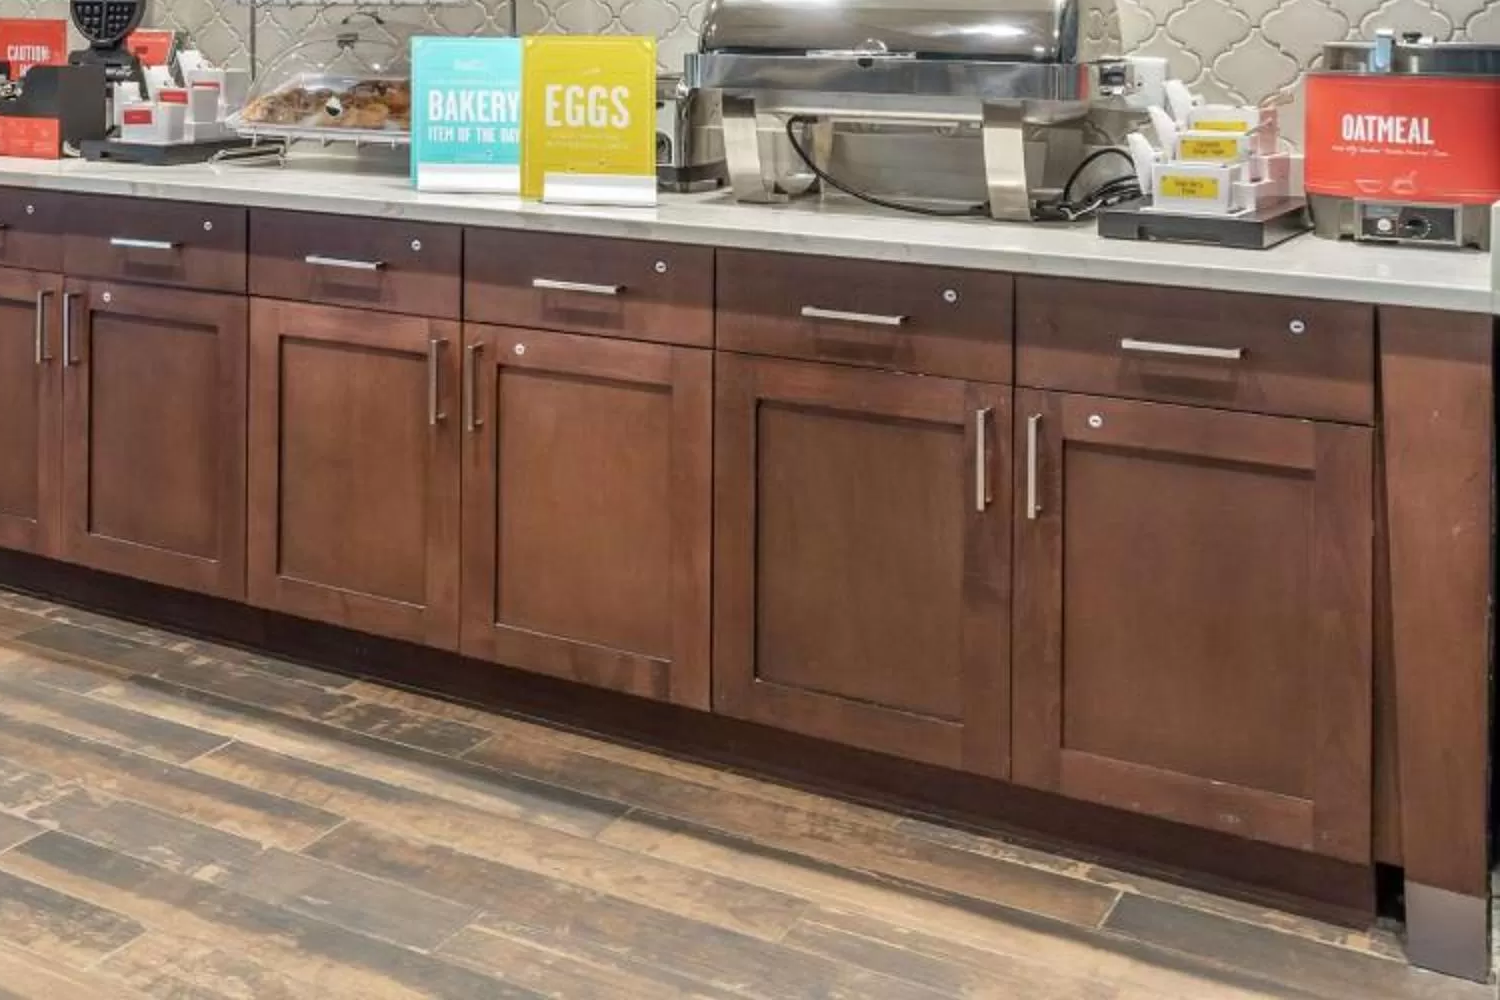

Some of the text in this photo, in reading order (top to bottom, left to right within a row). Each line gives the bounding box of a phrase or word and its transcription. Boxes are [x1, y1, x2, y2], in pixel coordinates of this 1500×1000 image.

[428, 89, 520, 123] BAKERY
[545, 83, 630, 129] EGGS
[1341, 113, 1435, 145] OATMEAL
